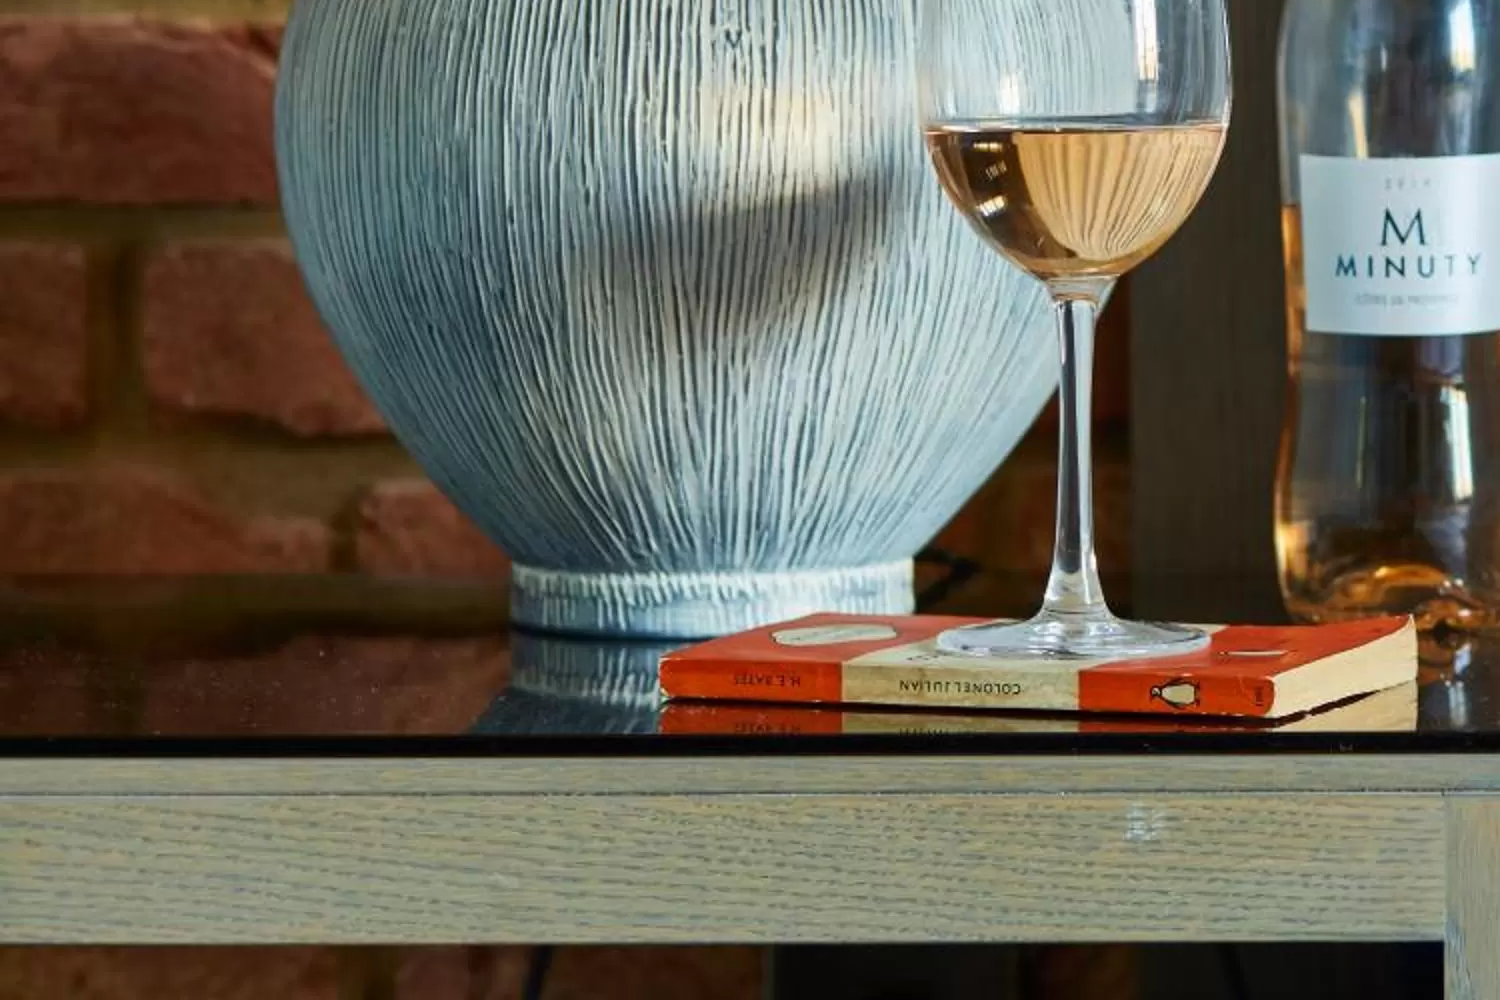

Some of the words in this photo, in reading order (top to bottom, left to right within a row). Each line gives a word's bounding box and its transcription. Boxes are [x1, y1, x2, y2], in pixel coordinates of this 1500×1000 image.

[1380, 207, 1427, 247] M
[1335, 252, 1482, 279] MINUTY
[900, 679, 950, 693] JULIAN
[954, 681, 1022, 696] COLONEL
